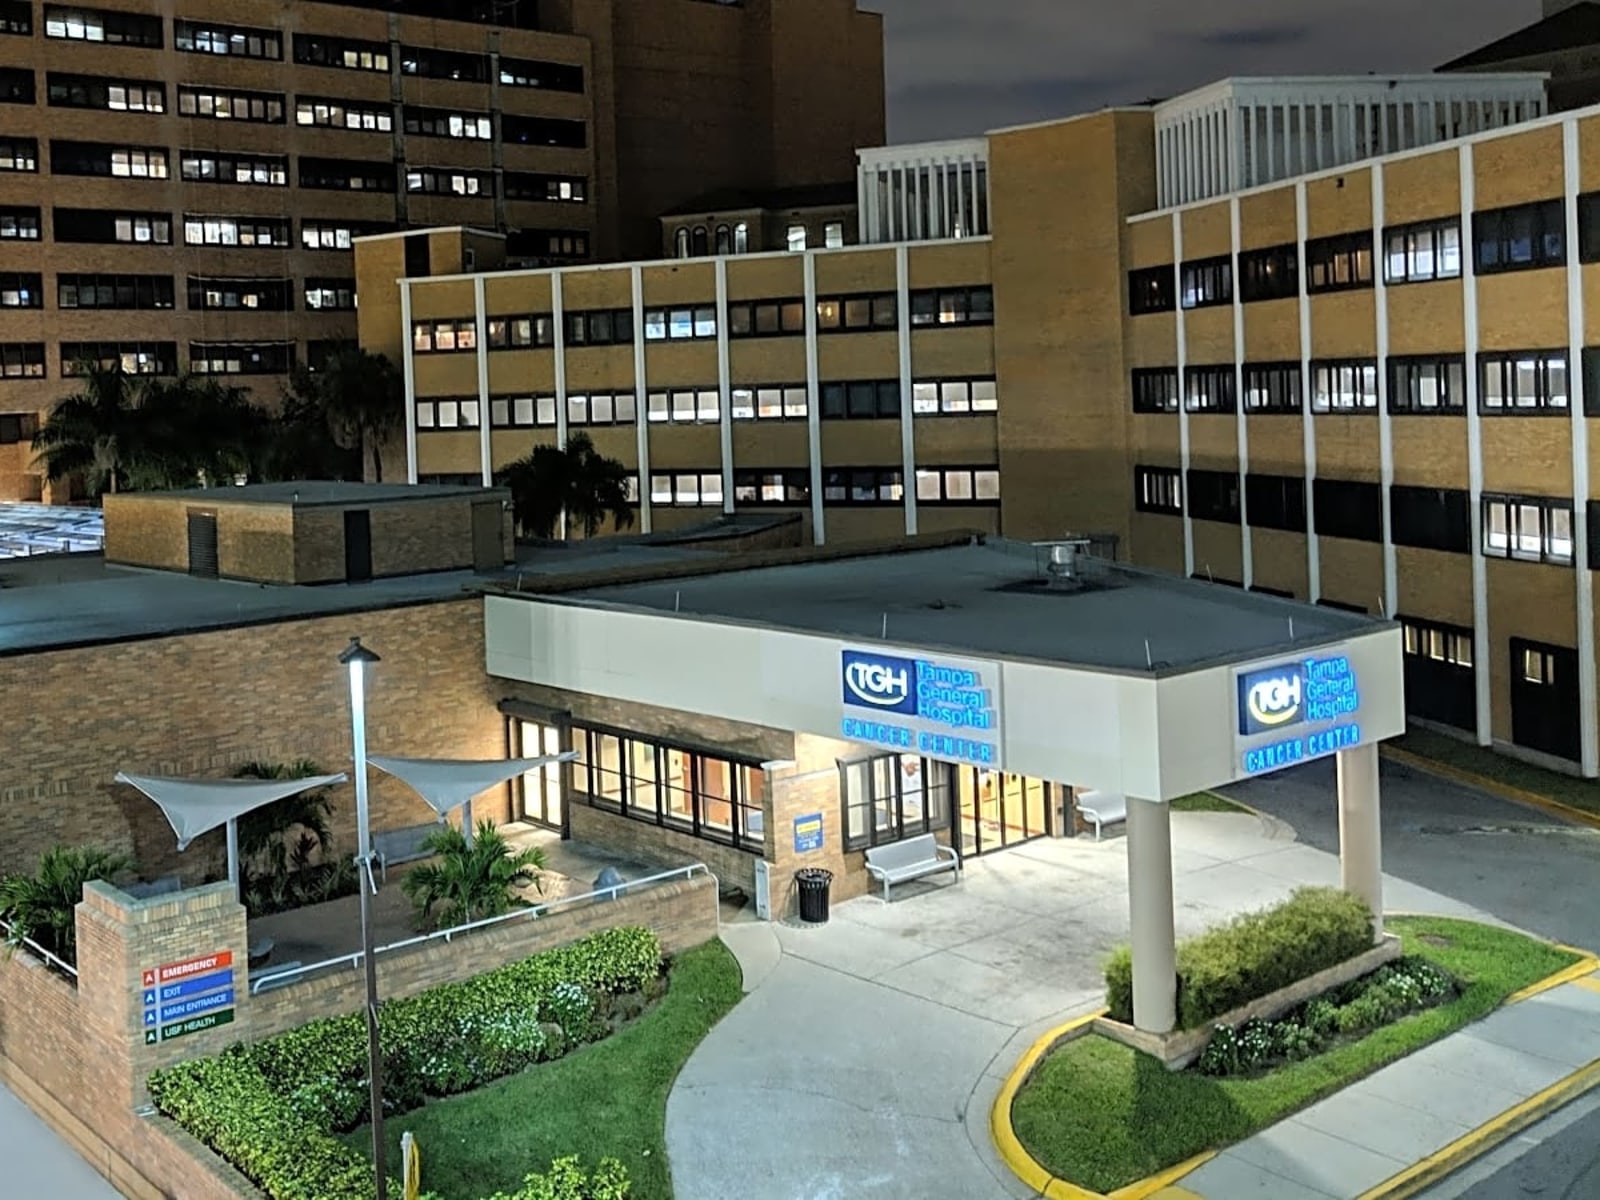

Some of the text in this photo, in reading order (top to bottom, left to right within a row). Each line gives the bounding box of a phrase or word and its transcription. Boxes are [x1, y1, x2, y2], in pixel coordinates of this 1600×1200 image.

[853, 662, 908, 697] TGH
[915, 660, 976, 687] Tampa
[1305, 657, 1348, 680] Tampa
[916, 681, 986, 708] General
[1255, 674, 1301, 713] TGH
[1306, 671, 1355, 702] General
[917, 703, 992, 729] Hospital
[1307, 692, 1358, 721] Hospital
[842, 718, 994, 763] CANCER CENTER
[1247, 724, 1360, 773] CANCER CENTER
[162, 957, 217, 978] EMERGENCY
[163, 985, 181, 998] EXIT
[163, 993, 227, 1017] MAIN ENTRANCE
[164, 1015, 216, 1037] USF HEALTH
